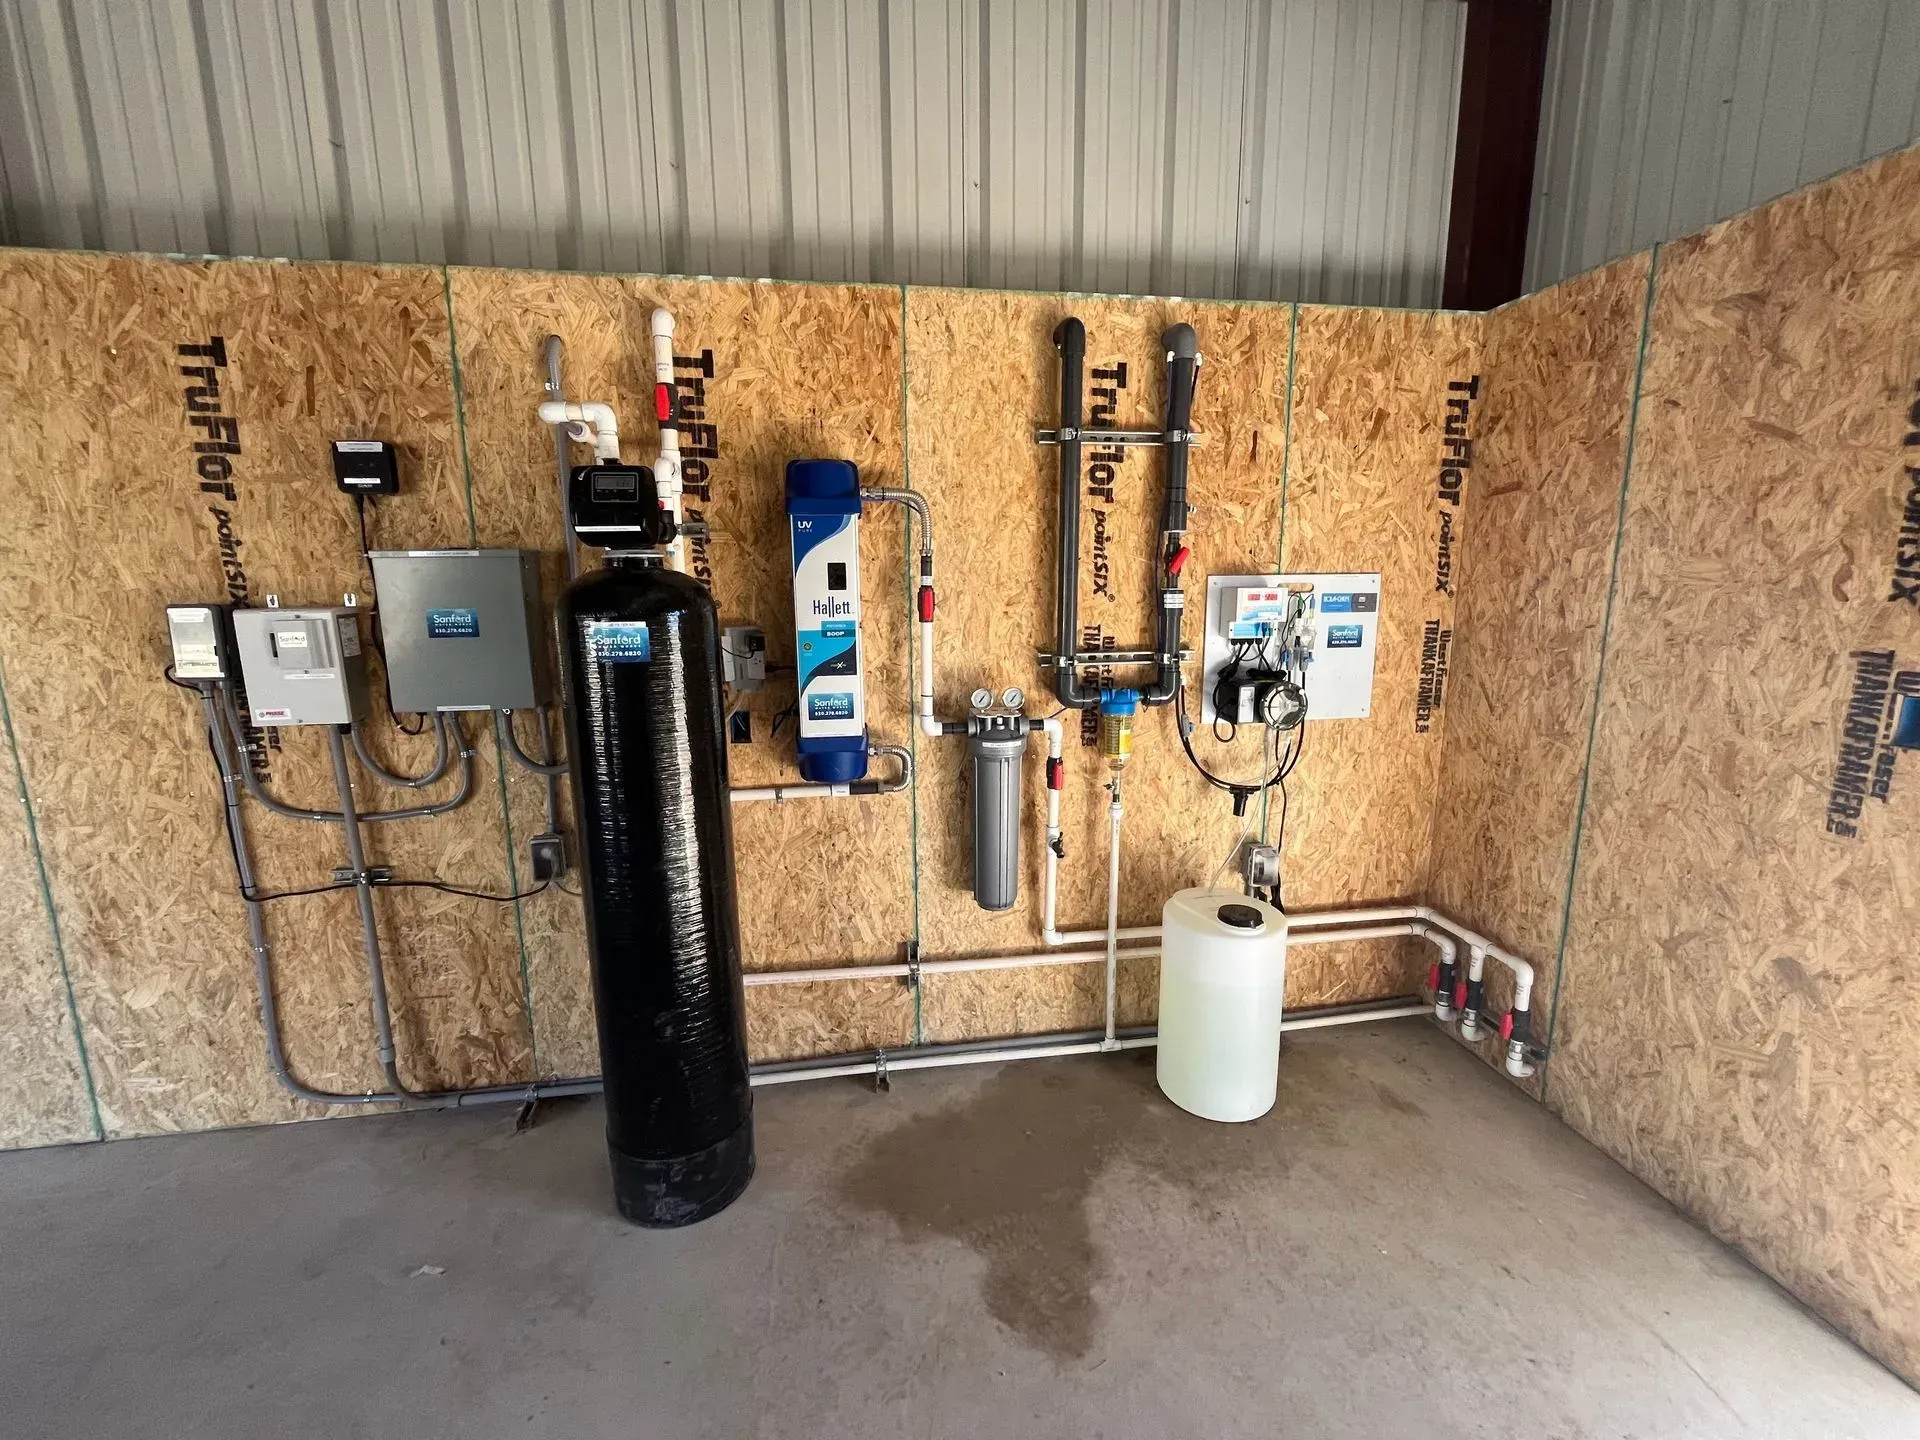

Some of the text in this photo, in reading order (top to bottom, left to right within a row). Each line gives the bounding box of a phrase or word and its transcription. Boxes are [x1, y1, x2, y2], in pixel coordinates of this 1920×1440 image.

[177, 336, 242, 502] TruFlor
[672, 348, 720, 503] TruFlor
[1437, 374, 1480, 507] TruFlor
[797, 520, 813, 529] UV
[812, 596, 851, 618] Hallett
[433, 614, 471, 623] Sanford
[597, 634, 641, 645] Sanford
[814, 697, 848, 707] Sanford
